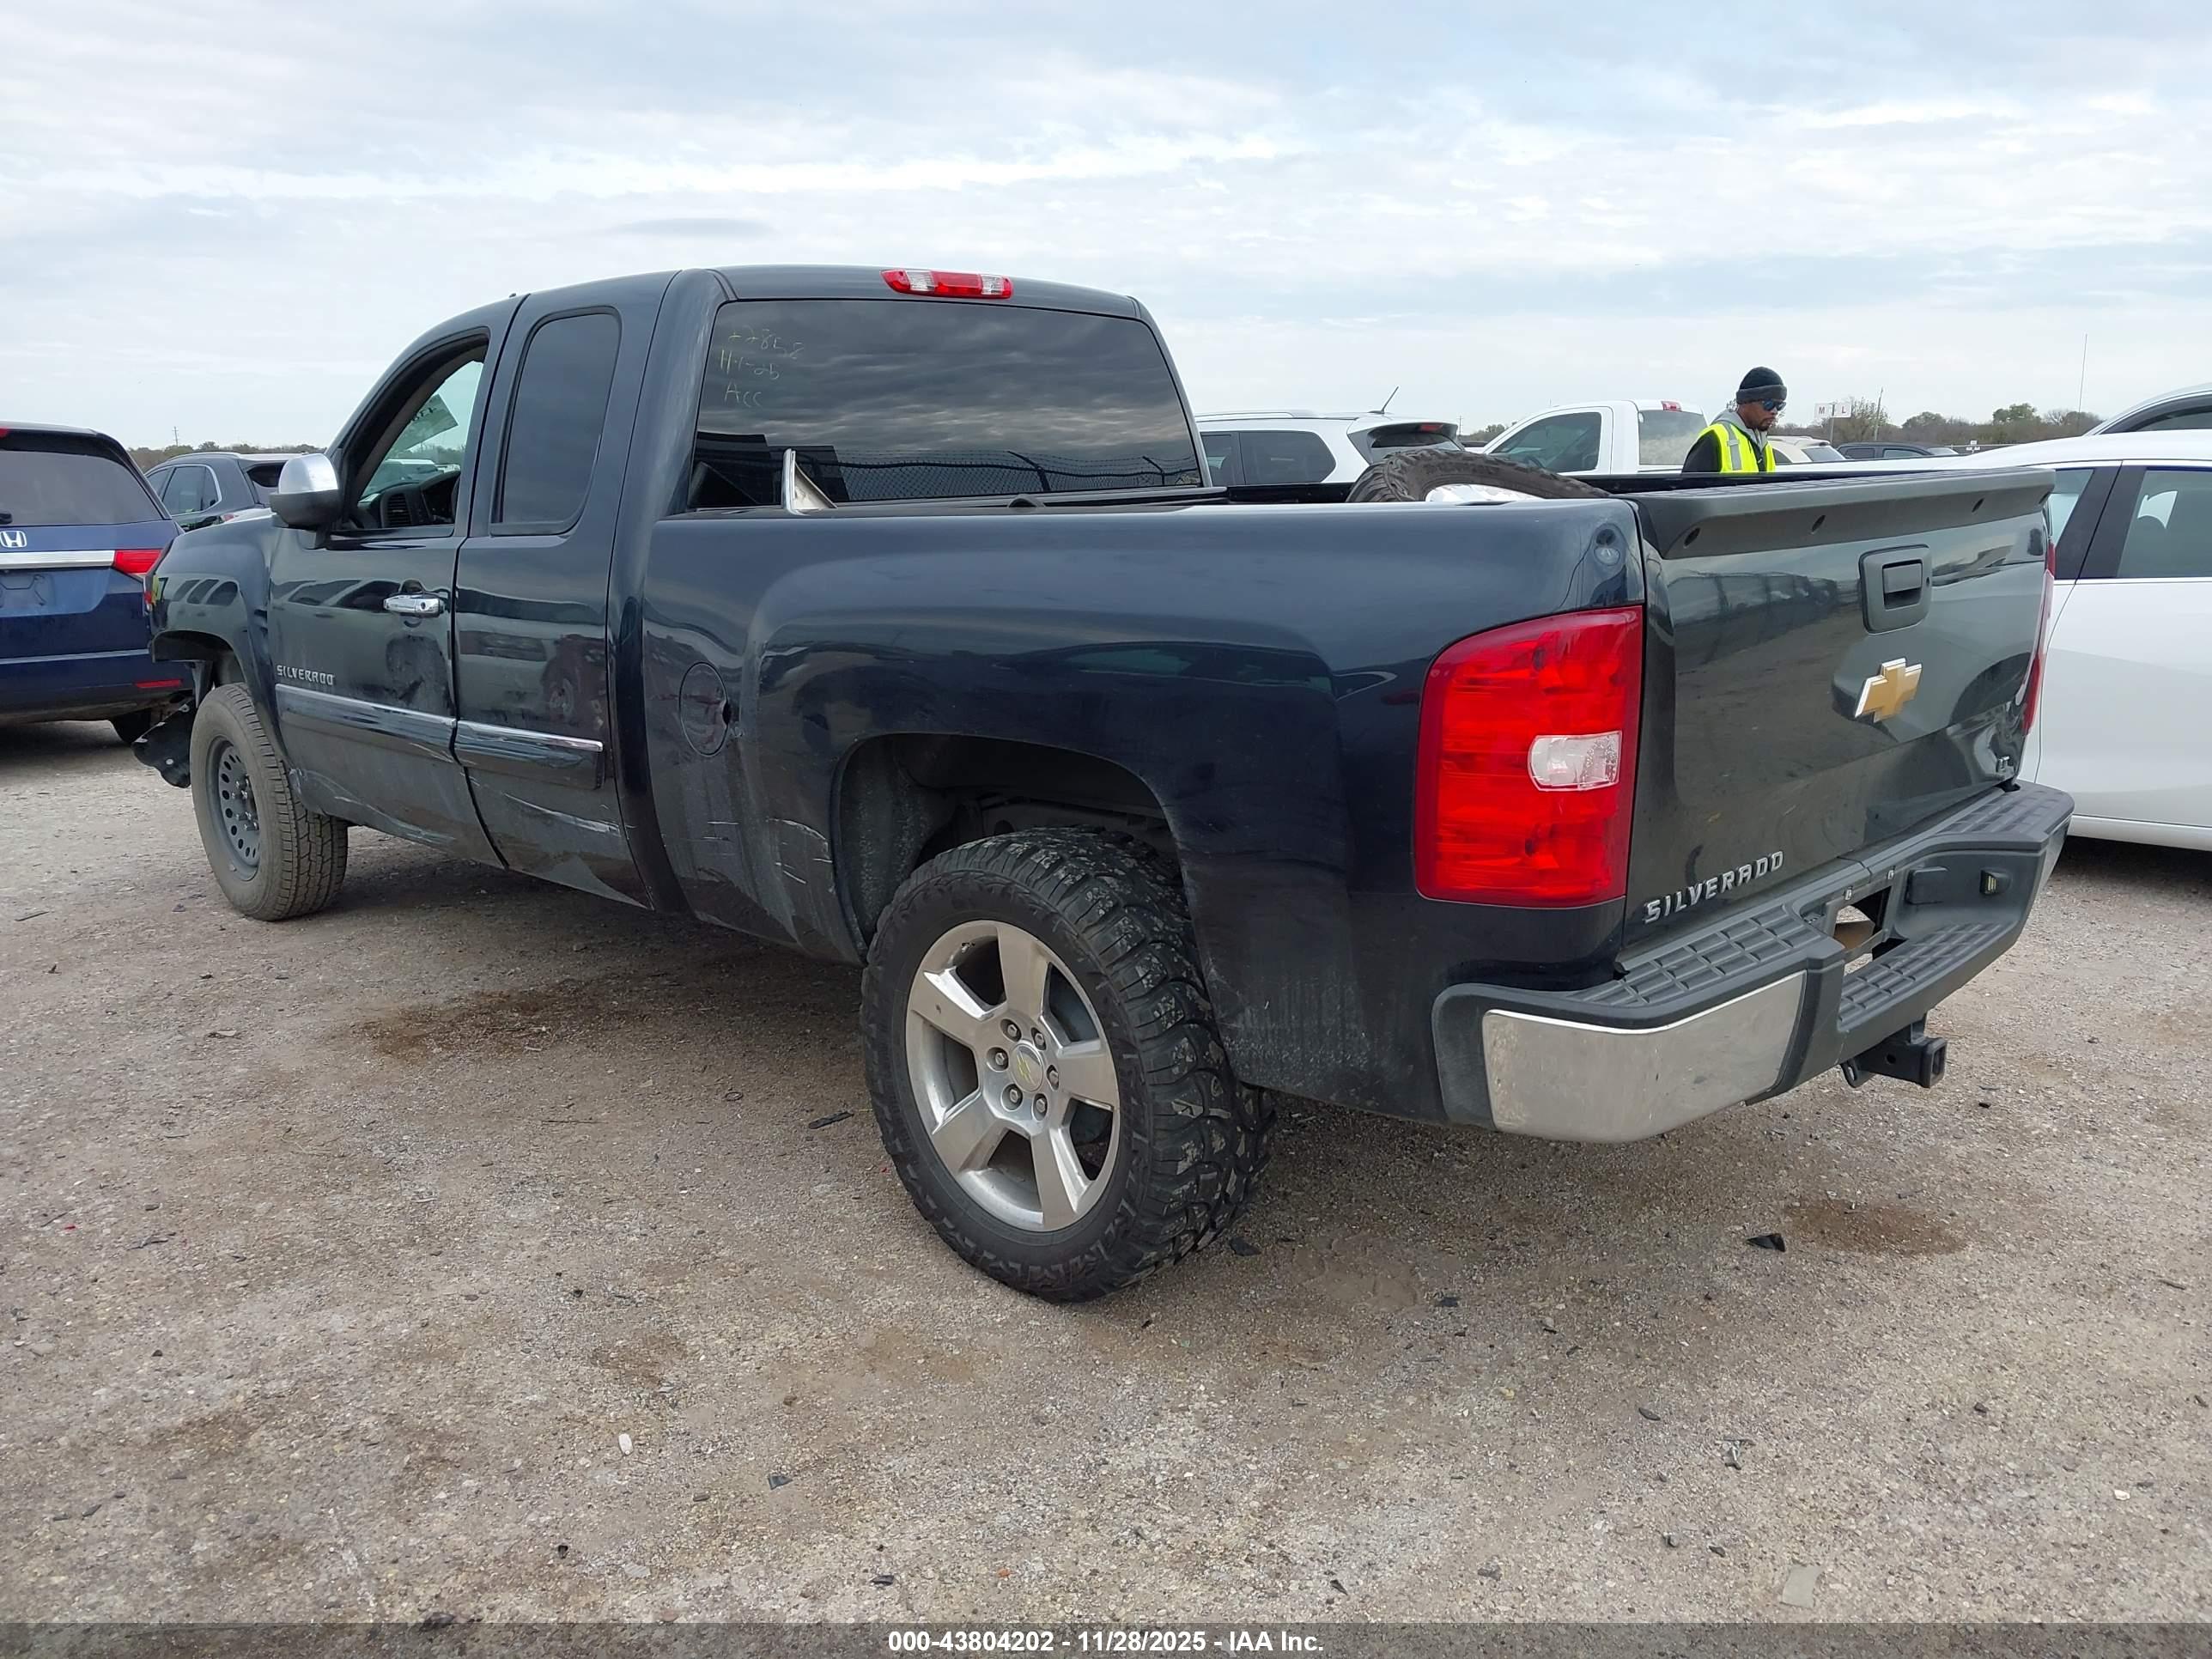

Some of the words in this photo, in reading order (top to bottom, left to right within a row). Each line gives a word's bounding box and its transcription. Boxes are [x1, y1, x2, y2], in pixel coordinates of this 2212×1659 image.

[1841, 405, 1847, 414] L
[276, 665, 335, 685] SILVERADO
[1644, 850, 1784, 924] SILVERADO
